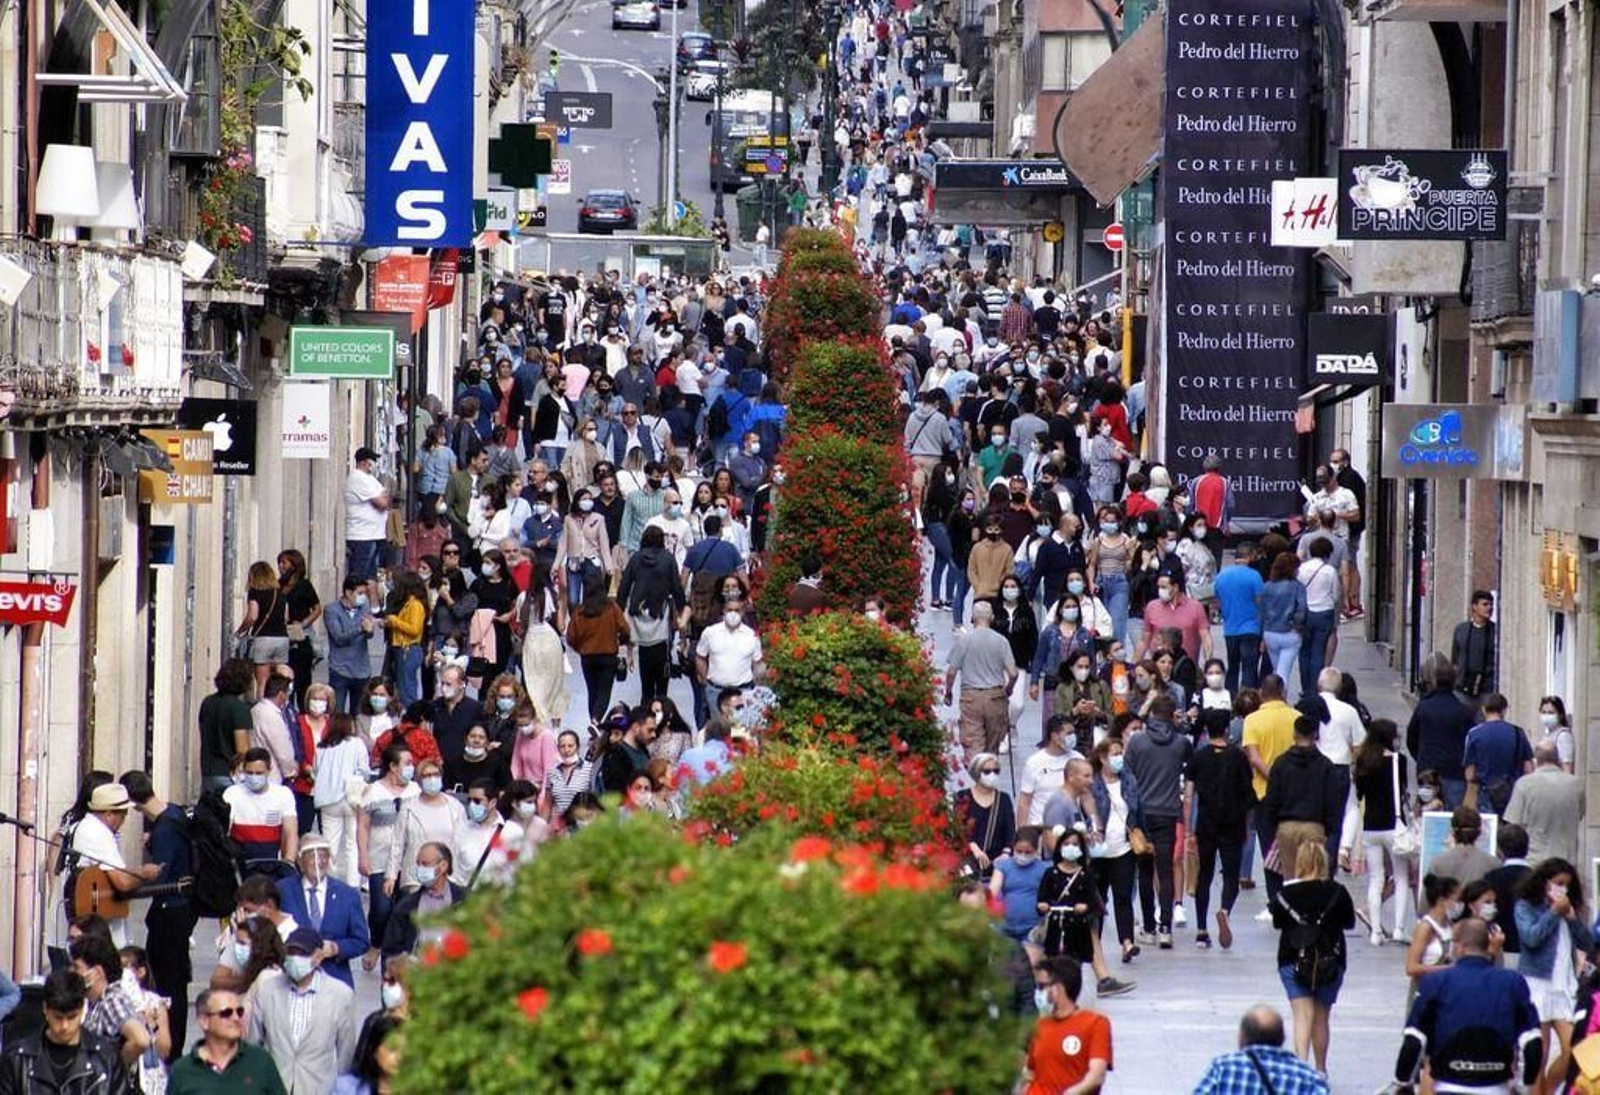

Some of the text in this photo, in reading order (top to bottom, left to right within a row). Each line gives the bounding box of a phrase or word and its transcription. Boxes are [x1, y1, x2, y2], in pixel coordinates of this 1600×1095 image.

[1178, 13, 1299, 27] CORTEFIEL
[1179, 41, 1299, 60] Pedro del Hierro
[1177, 86, 1297, 99] CORTEFIEL
[1177, 114, 1297, 132] Pedro del Hierro
[1177, 159, 1296, 171] CORTEFIEL
[1020, 167, 1068, 182] CaixaBank
[1179, 186, 1272, 204] Pedro del Hie
[1429, 190, 1498, 205] PUERTA
[1352, 206, 1496, 231] PRINCIPE
[1175, 231, 1268, 243] CORTEFI
[1177, 259, 1295, 276] Pedro del Hierro
[1176, 303, 1295, 316] CORTEFIEL
[301, 342, 383, 353] UNITED COLORS
[1177, 332, 1295, 349] Pedro del Hierro
[301, 353, 315, 362] OF
[1179, 376, 1297, 389] CORTEFIEL
[1180, 404, 1297, 422] Pedro del Hierro
[1177, 446, 1296, 459] CORTEFIEL
[1247, 476, 1295, 492] Hierro
